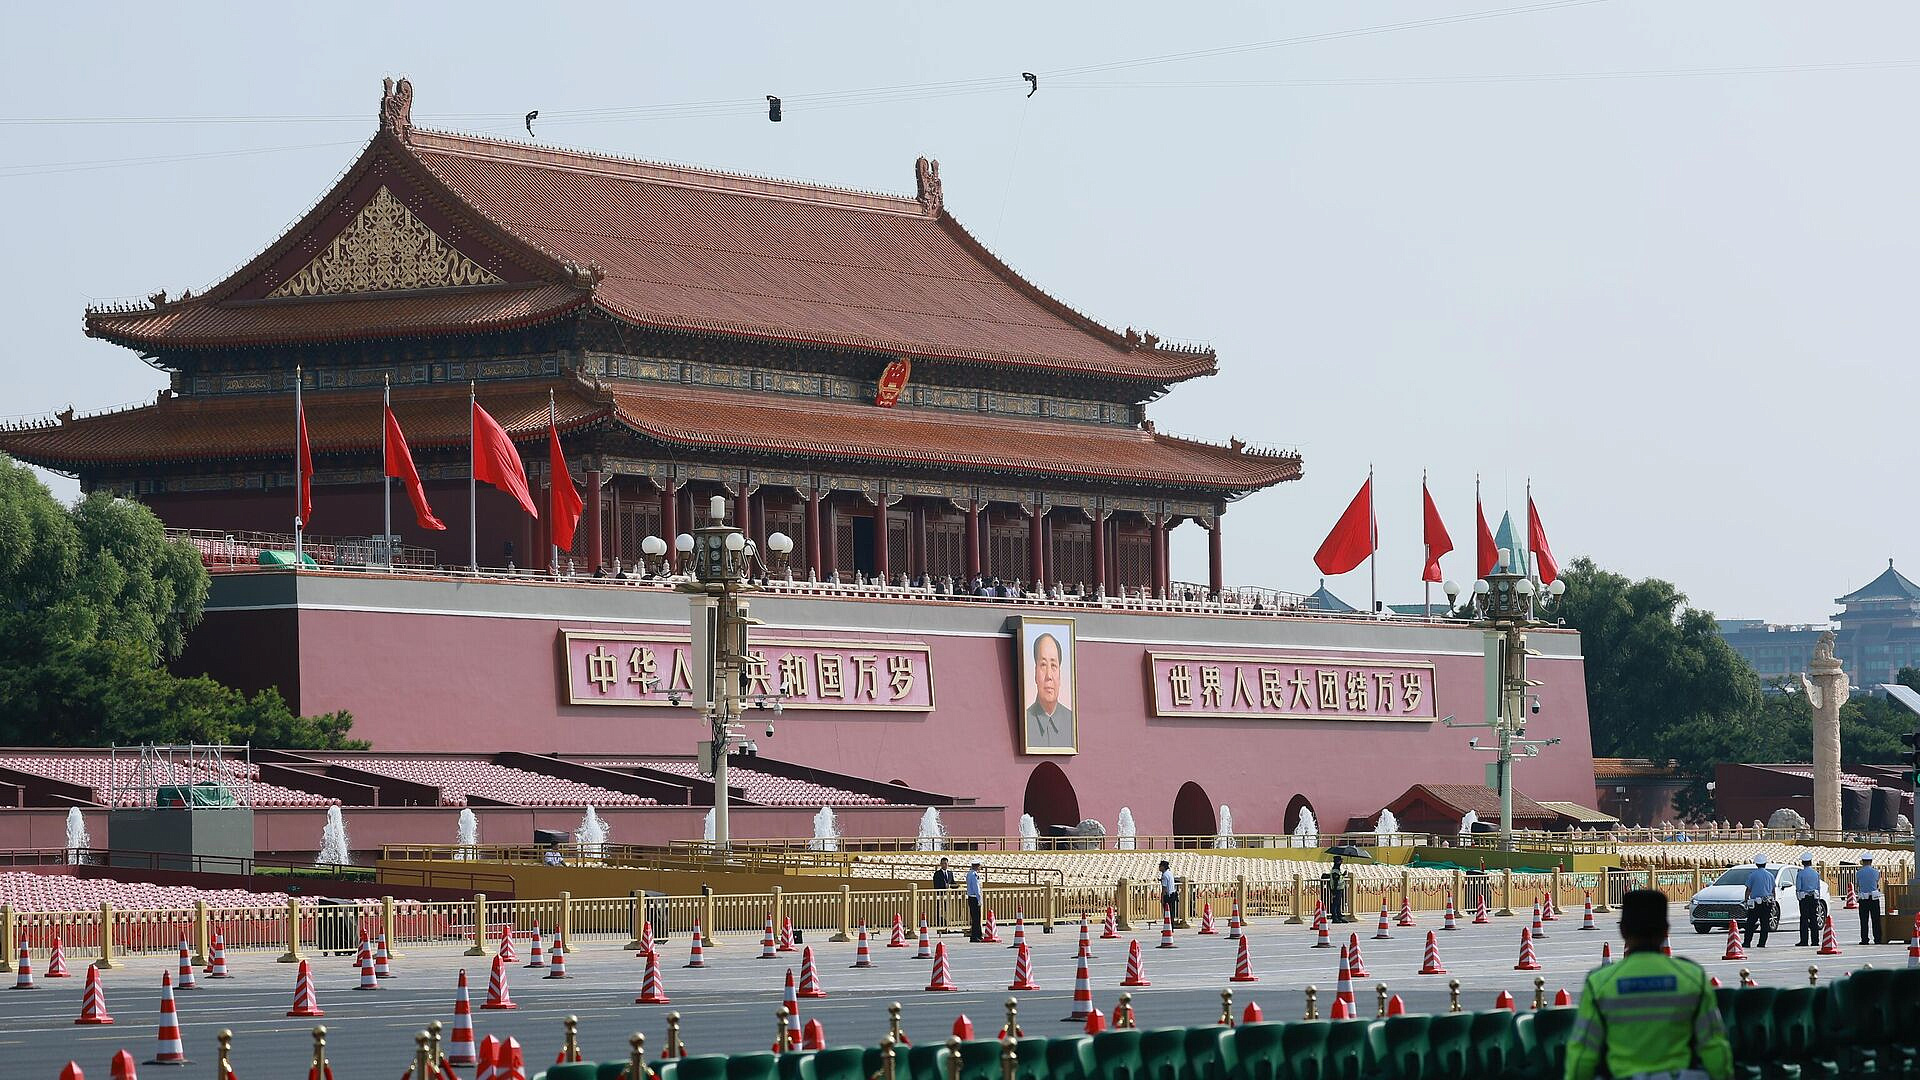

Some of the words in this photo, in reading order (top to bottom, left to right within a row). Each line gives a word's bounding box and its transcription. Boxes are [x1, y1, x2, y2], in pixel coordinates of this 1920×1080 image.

[587, 646, 914, 700] 中华人共和国万岁
[1170, 665, 1423, 712] 世界人民大团结万岁
